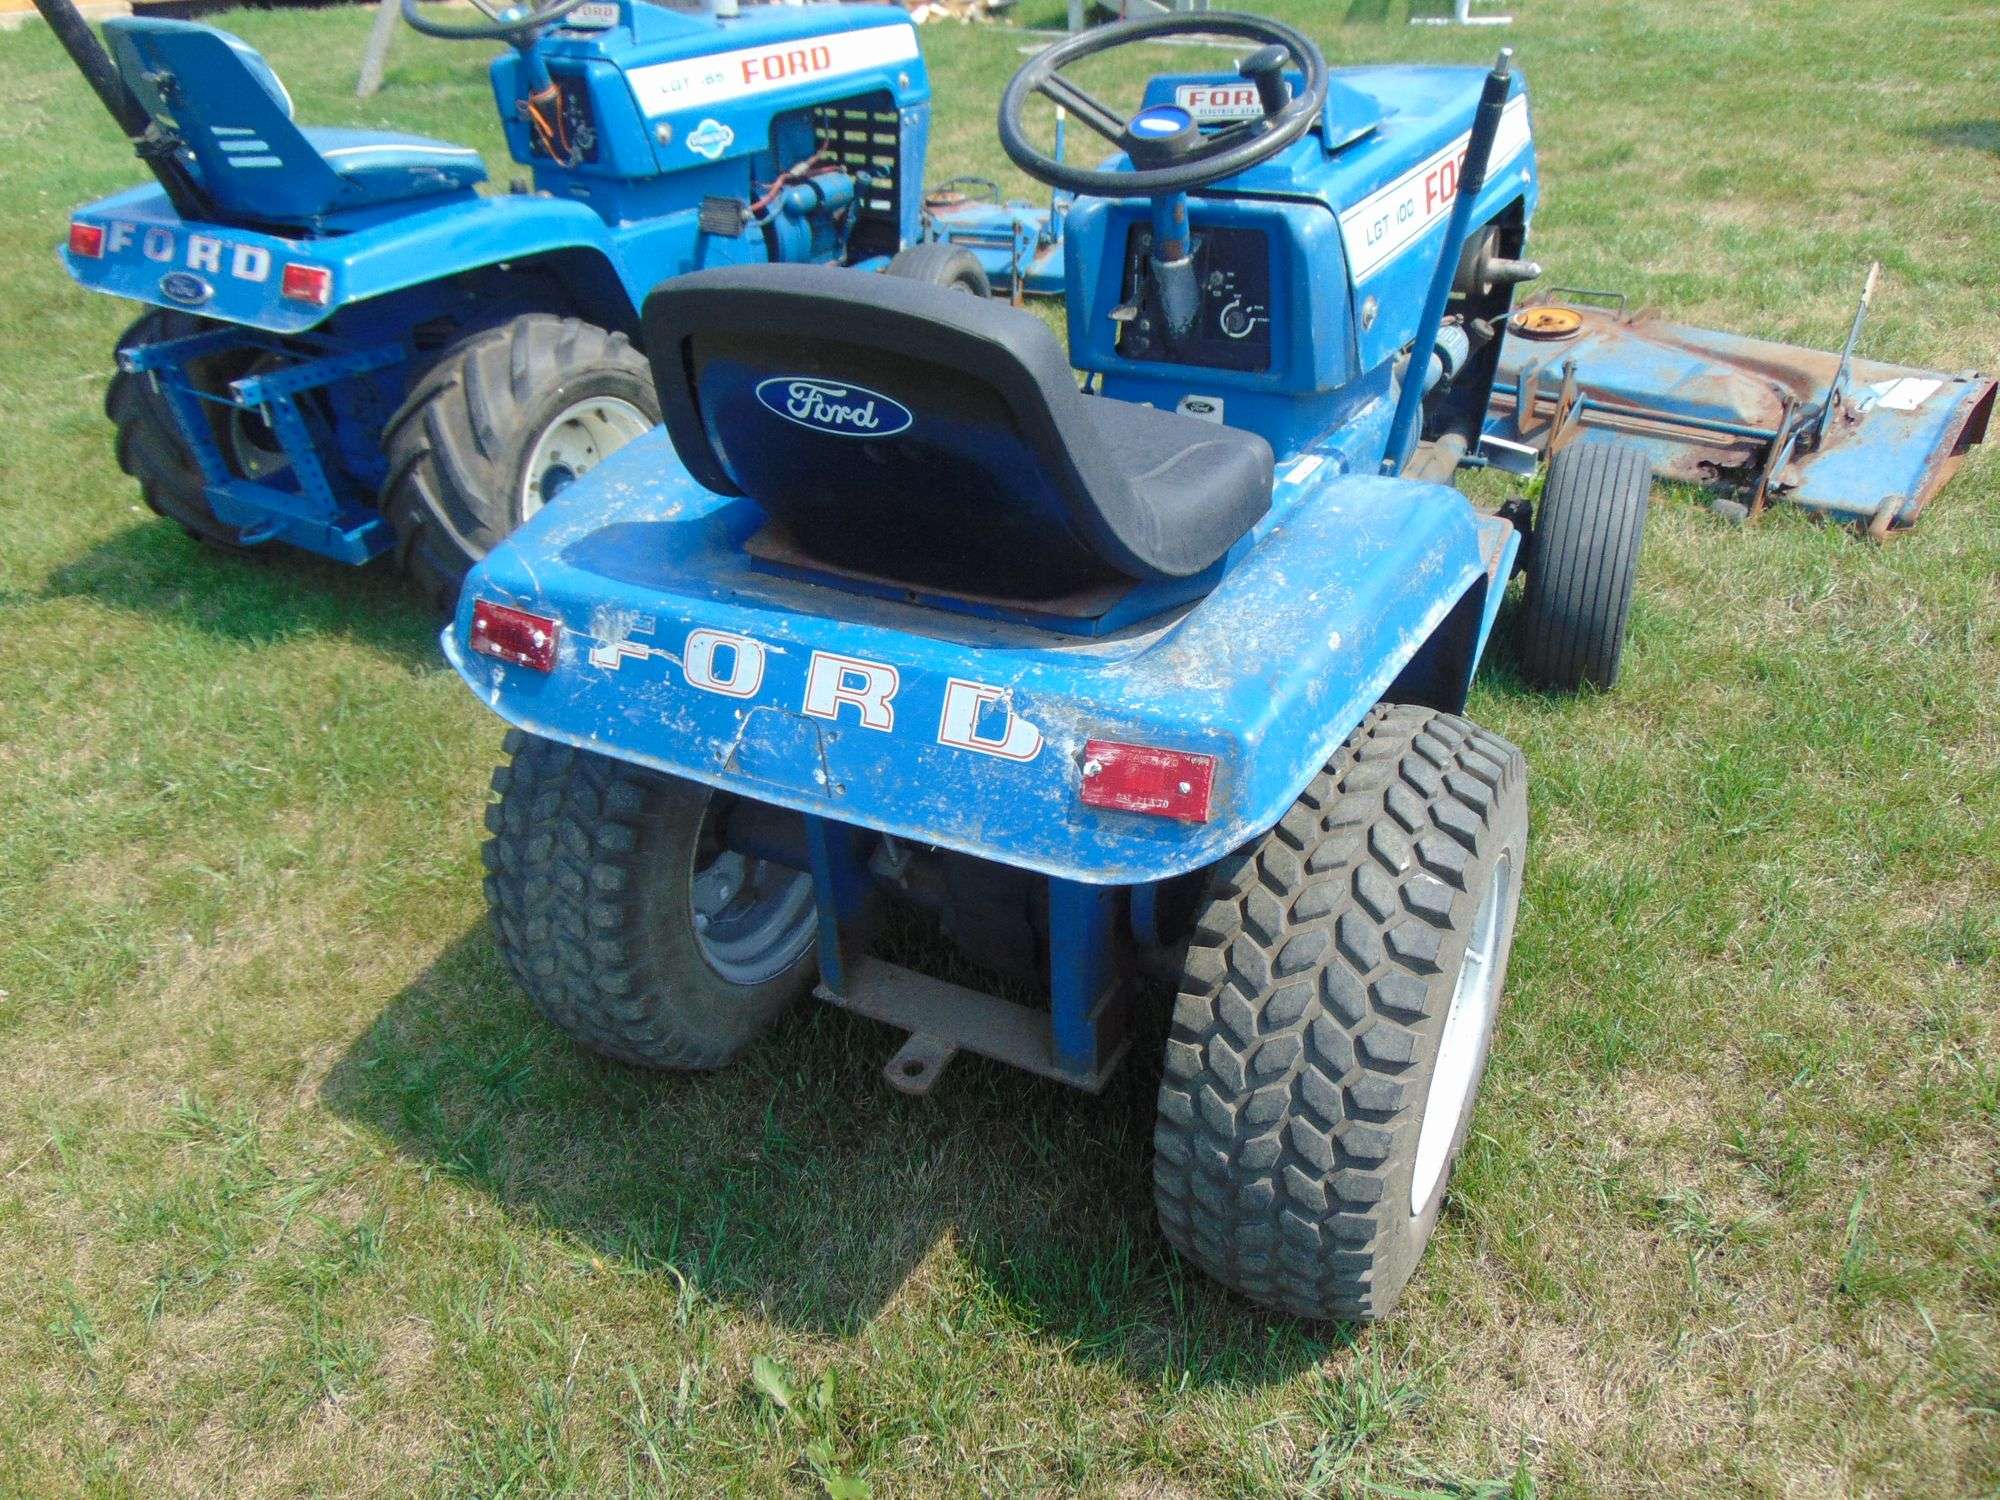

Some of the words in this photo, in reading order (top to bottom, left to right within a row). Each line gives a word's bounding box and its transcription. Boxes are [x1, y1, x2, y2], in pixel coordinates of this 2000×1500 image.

[582, 6, 614, 17] ORD
[741, 45, 831, 84] FORD
[1188, 90, 1256, 107] FOR
[1366, 214, 1390, 247] LGT
[1397, 198, 1415, 225] 100
[107, 221, 272, 283] FORD
[786, 382, 880, 429] Ford
